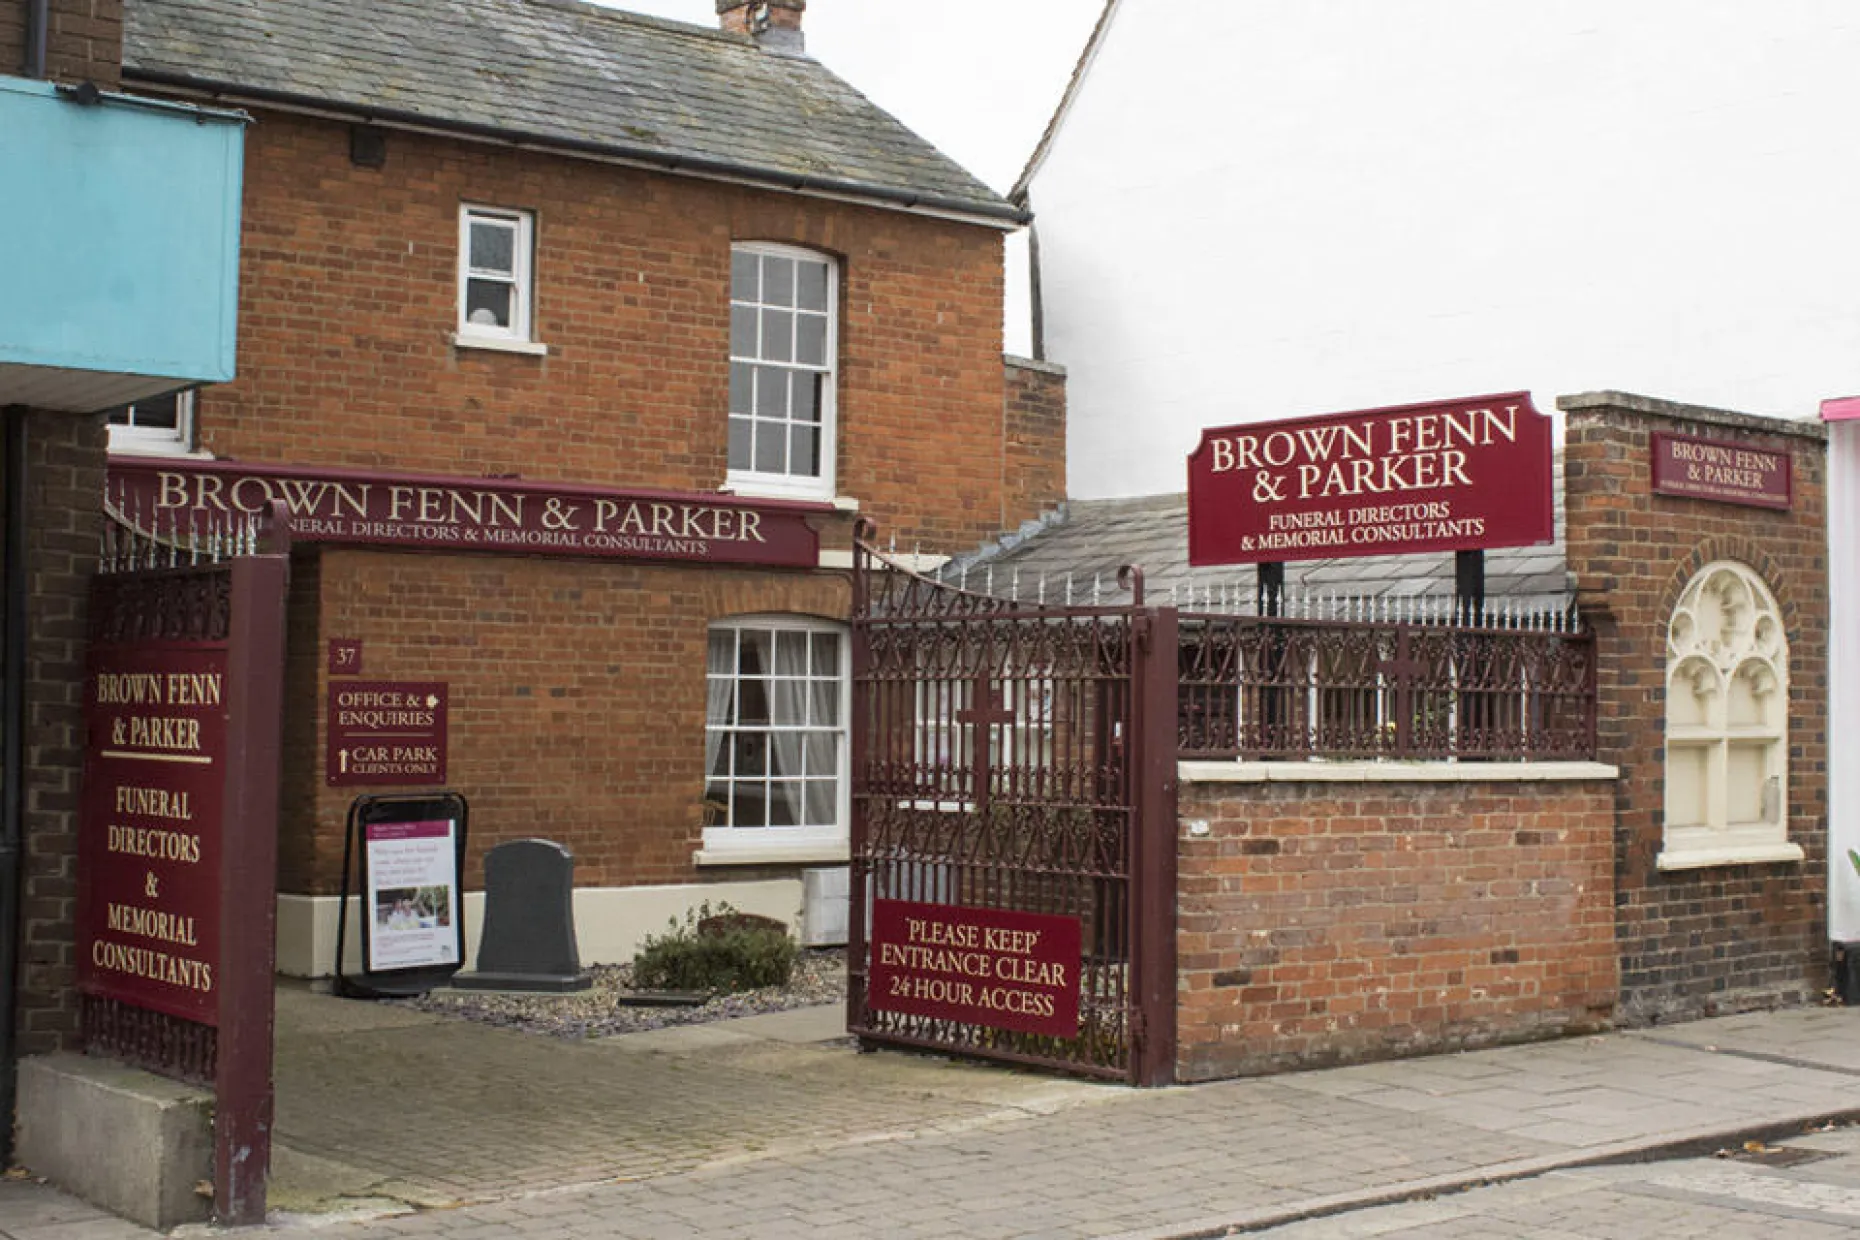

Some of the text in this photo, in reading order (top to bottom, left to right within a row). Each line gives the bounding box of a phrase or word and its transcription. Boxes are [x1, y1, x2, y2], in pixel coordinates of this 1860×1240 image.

[1211, 407, 1519, 471] BROWN FENN
[1672, 441, 1776, 471] BROWN FENN
[1253, 451, 1473, 502] & PARKER
[1688, 464, 1763, 489] & PARKER
[156, 472, 767, 543] BROWN FENN & PARKER
[1270, 502, 1450, 530] FUNERAL DIRECTORS
[352, 521, 463, 541] DIRECTORS
[464, 528, 479, 542] &
[483, 527, 581, 547] MEMORIAL
[584, 534, 709, 555] CONSULTANTS
[1241, 519, 1485, 551] & MEMORIAL CONSULTANTS
[336, 648, 356, 665] 37
[97, 673, 221, 706] BROWN FENN
[338, 692, 420, 707] OFFICE &
[112, 717, 200, 750] & PARKER
[338, 710, 435, 729] ENQUIRIES
[352, 747, 438, 762] CAR PARK
[352, 762, 401, 774] CLIENTS
[116, 786, 192, 820] FUNERAL
[108, 824, 200, 863] DIRECTORS
[145, 871, 159, 898] &
[108, 902, 197, 946] MEMORIAL
[908, 919, 1038, 953] PLEASE KEEP
[93, 939, 212, 992] CONSULTANTS
[881, 942, 1067, 987] ENTRANCE CLEAR
[889, 975, 1055, 1017] 24 HOUR ACCESS
